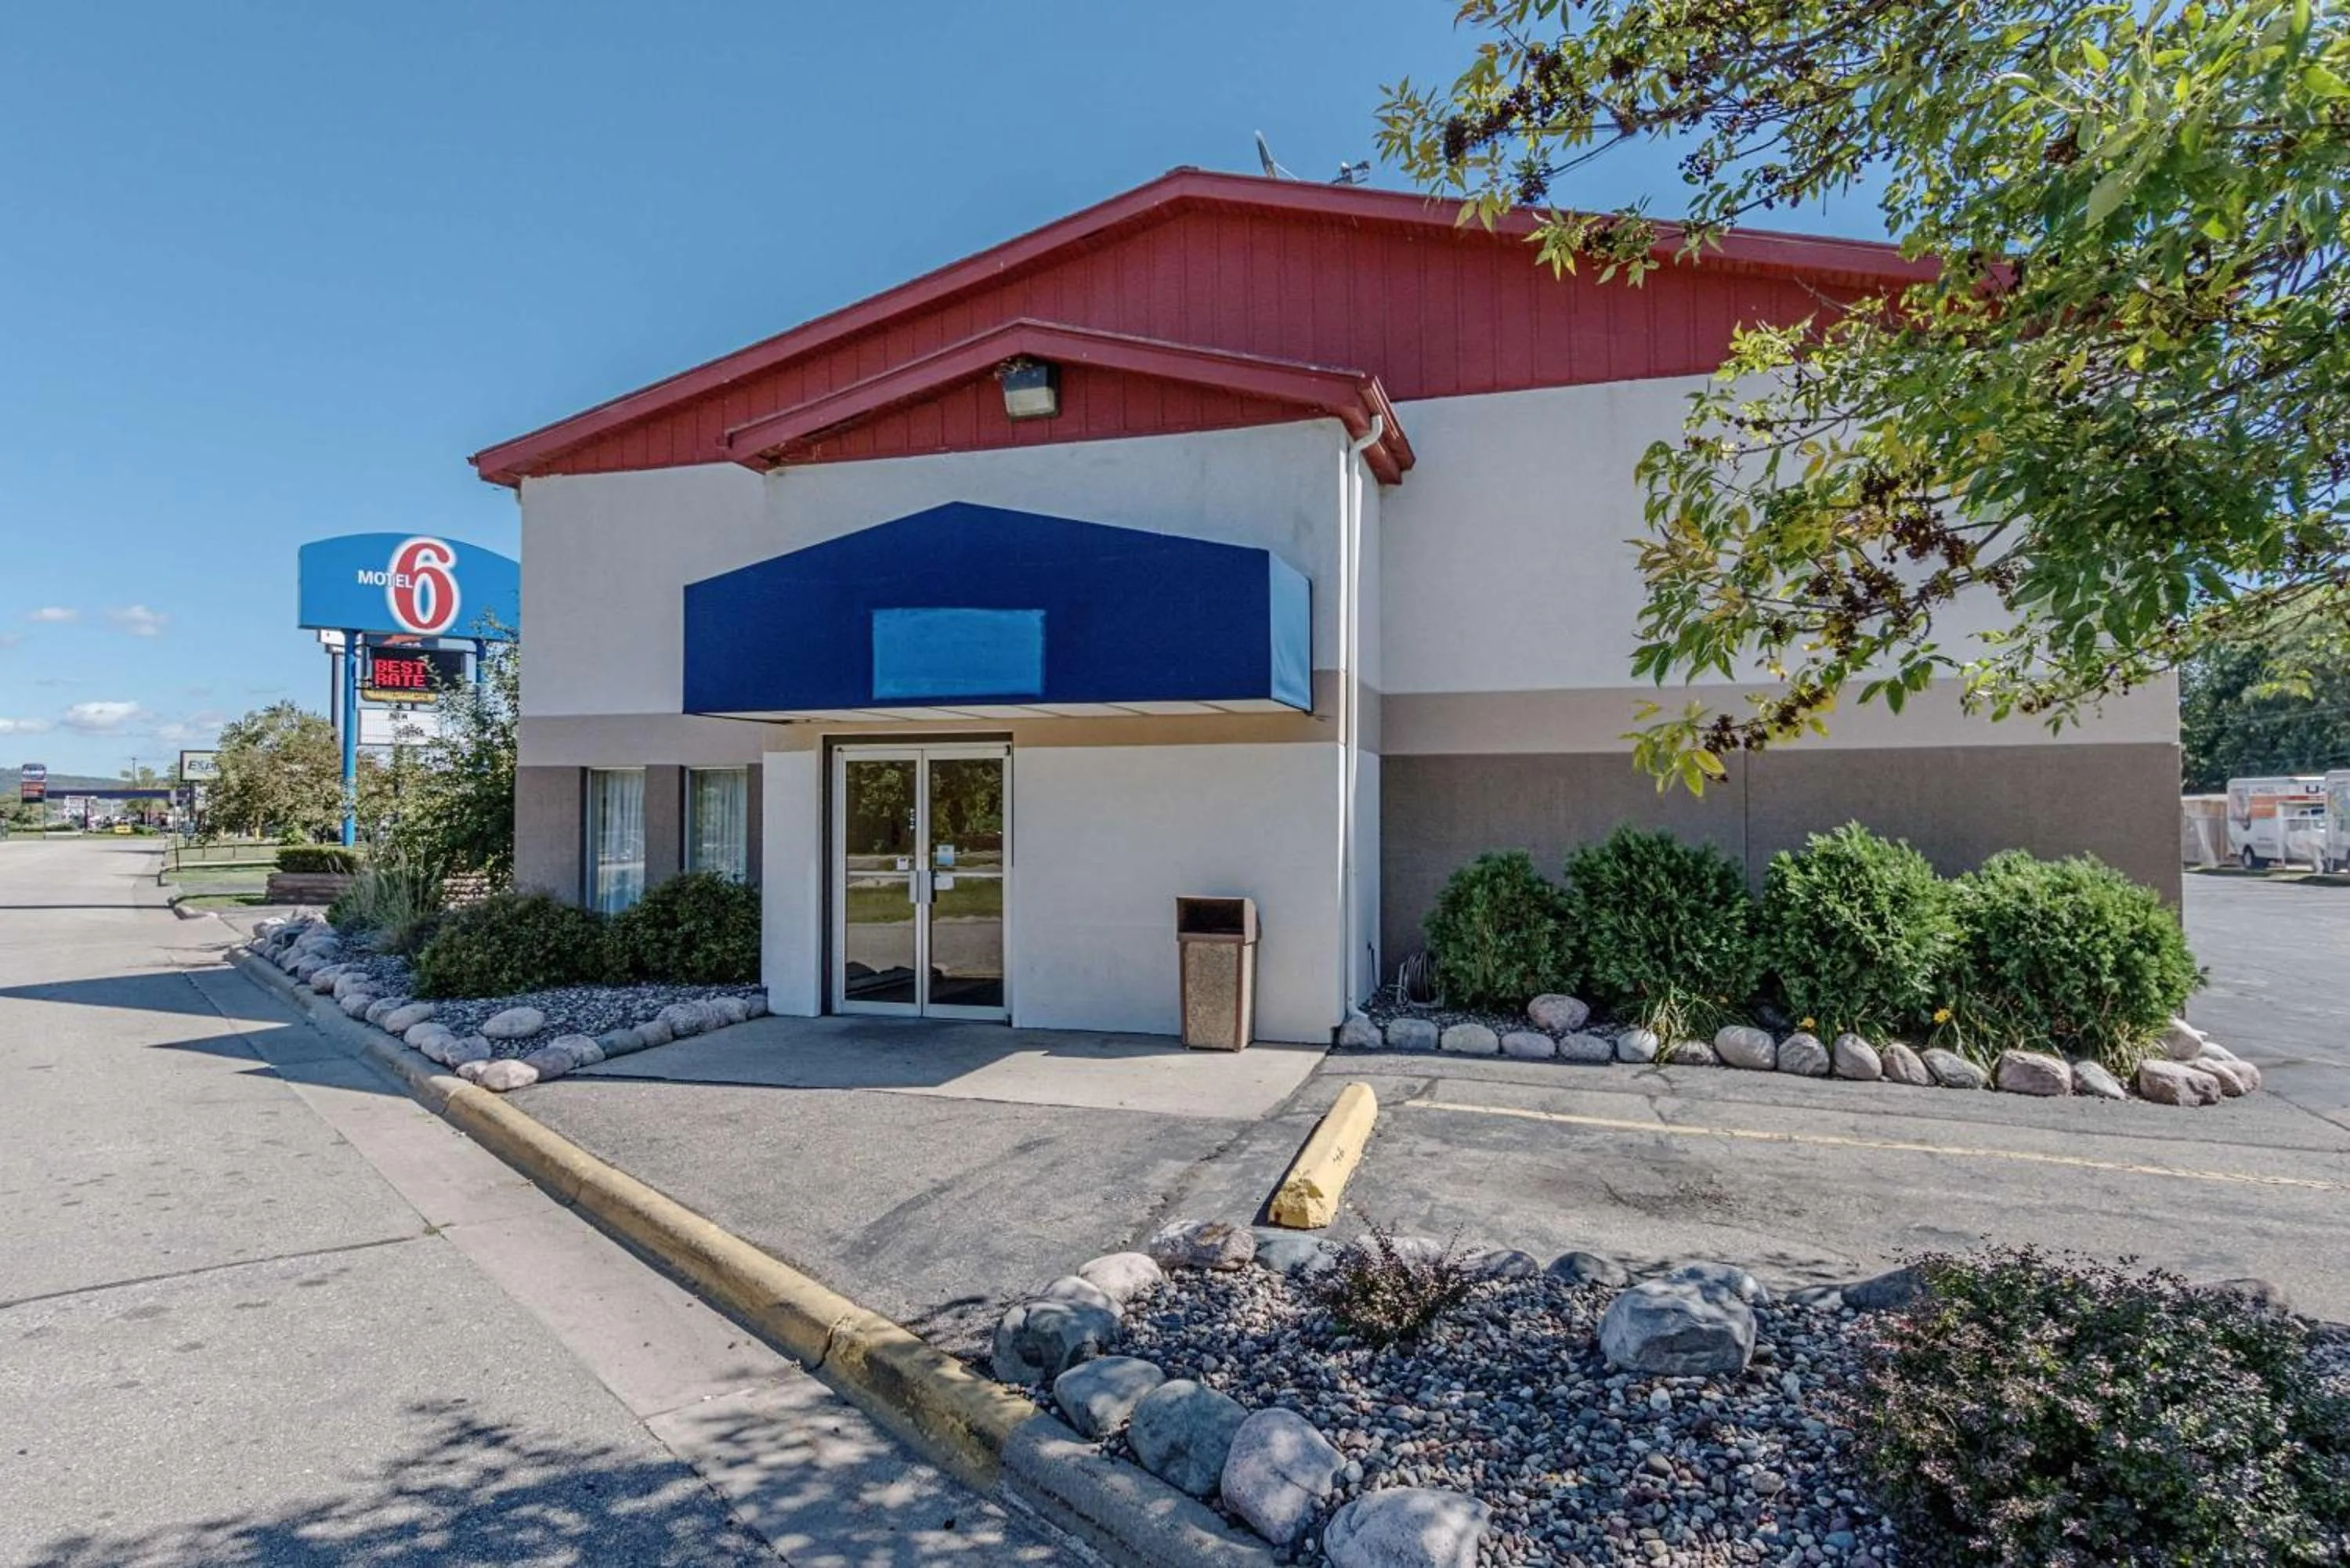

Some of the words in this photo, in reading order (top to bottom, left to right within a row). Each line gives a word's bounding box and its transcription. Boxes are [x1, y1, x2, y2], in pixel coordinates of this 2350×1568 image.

[357, 569, 414, 588] MOTEL
[387, 537, 460, 633] 6
[374, 659, 426, 674] BEST
[374, 674, 425, 687] RATE
